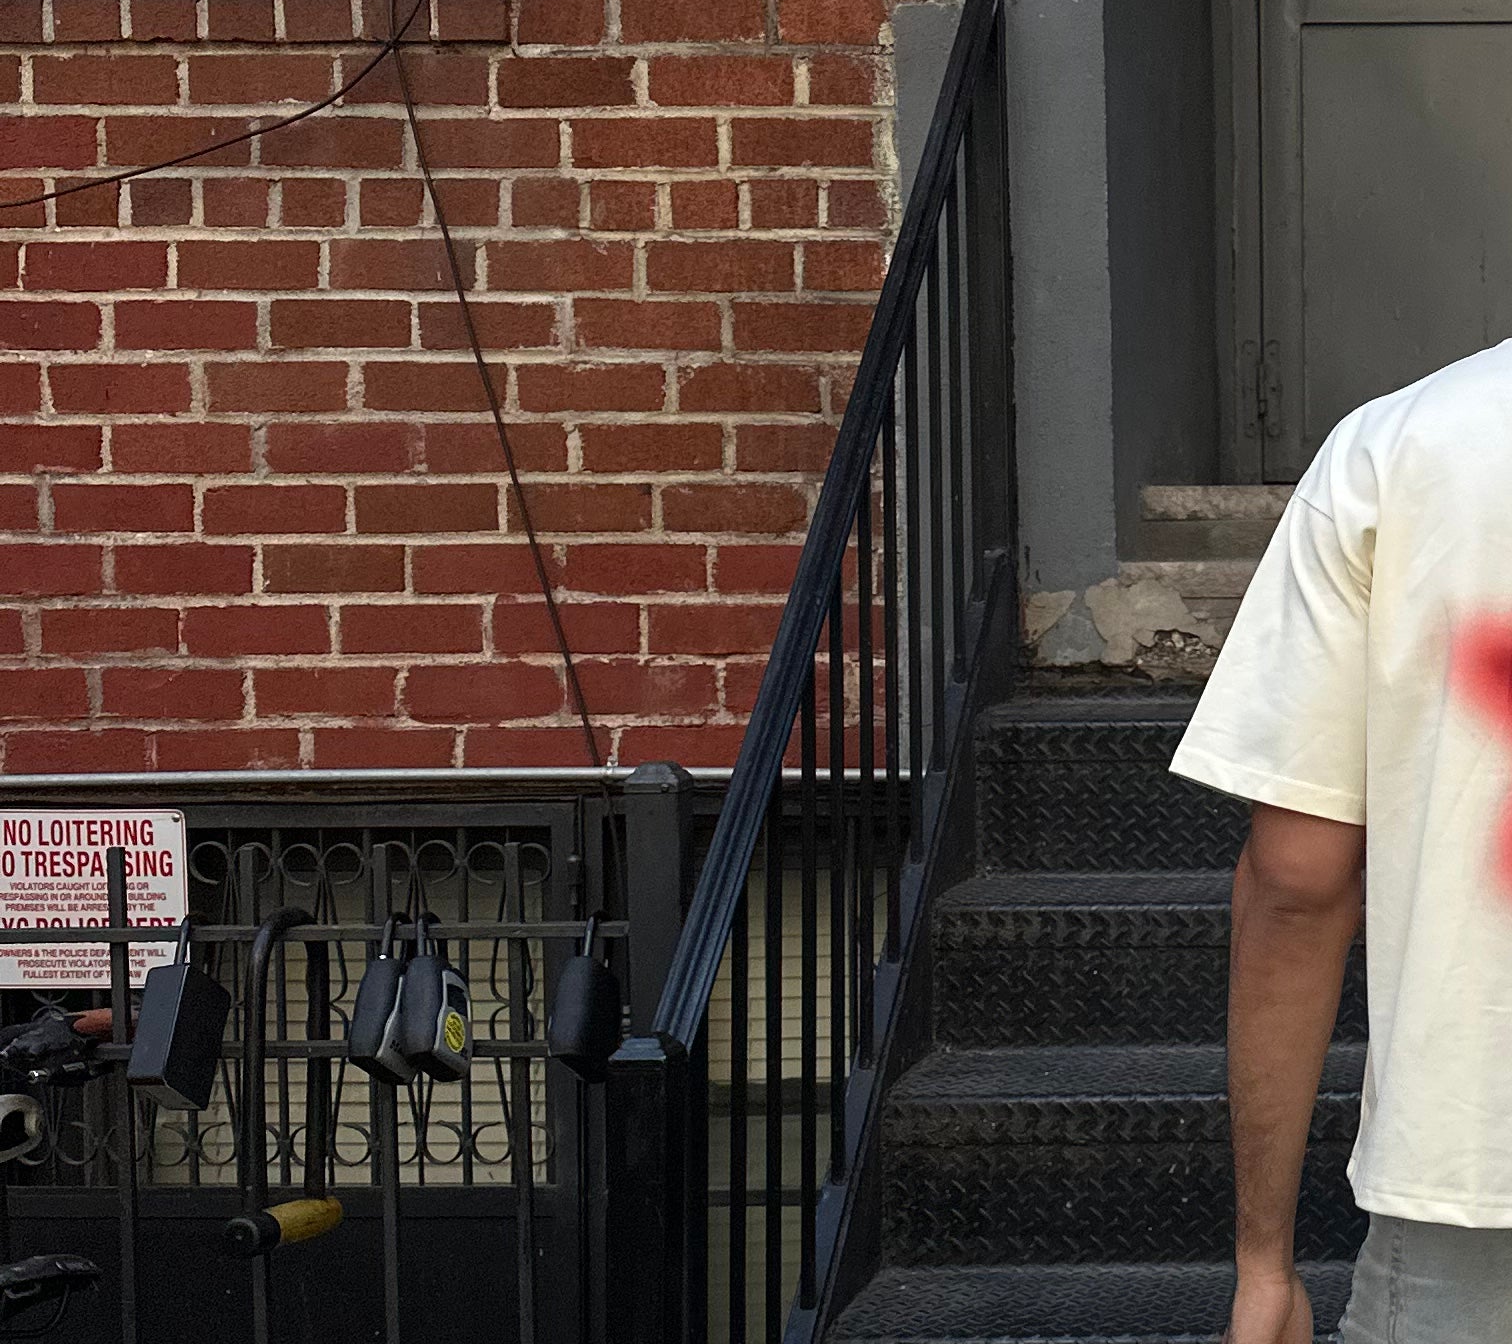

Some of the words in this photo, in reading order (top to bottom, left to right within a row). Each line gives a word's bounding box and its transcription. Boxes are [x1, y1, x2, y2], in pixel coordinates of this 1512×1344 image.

[3, 820, 31, 845] NO
[38, 820, 154, 846] LOITERING
[2, 850, 15, 877] O
[21, 851, 173, 877] TRESPASING
[10, 882, 55, 890] VIOLATORS
[56, 882, 90, 890] CAUGHT
[137, 882, 149, 890] OR
[5, 903, 45, 911] PREMISES
[81, 903, 109, 911] ARRES
[139, 903, 155, 911] THE
[41, 949, 57, 957] THE
[59, 949, 88, 957] POLICE
[90, 949, 145, 957] DEPAENT
[147, 949, 166, 957] WILL
[18, 960, 66, 968] PROSECUTE
[69, 959, 111, 968] VIOLATOR
[130, 959, 146, 967] THE
[23, 970, 58, 978] FULLEST
